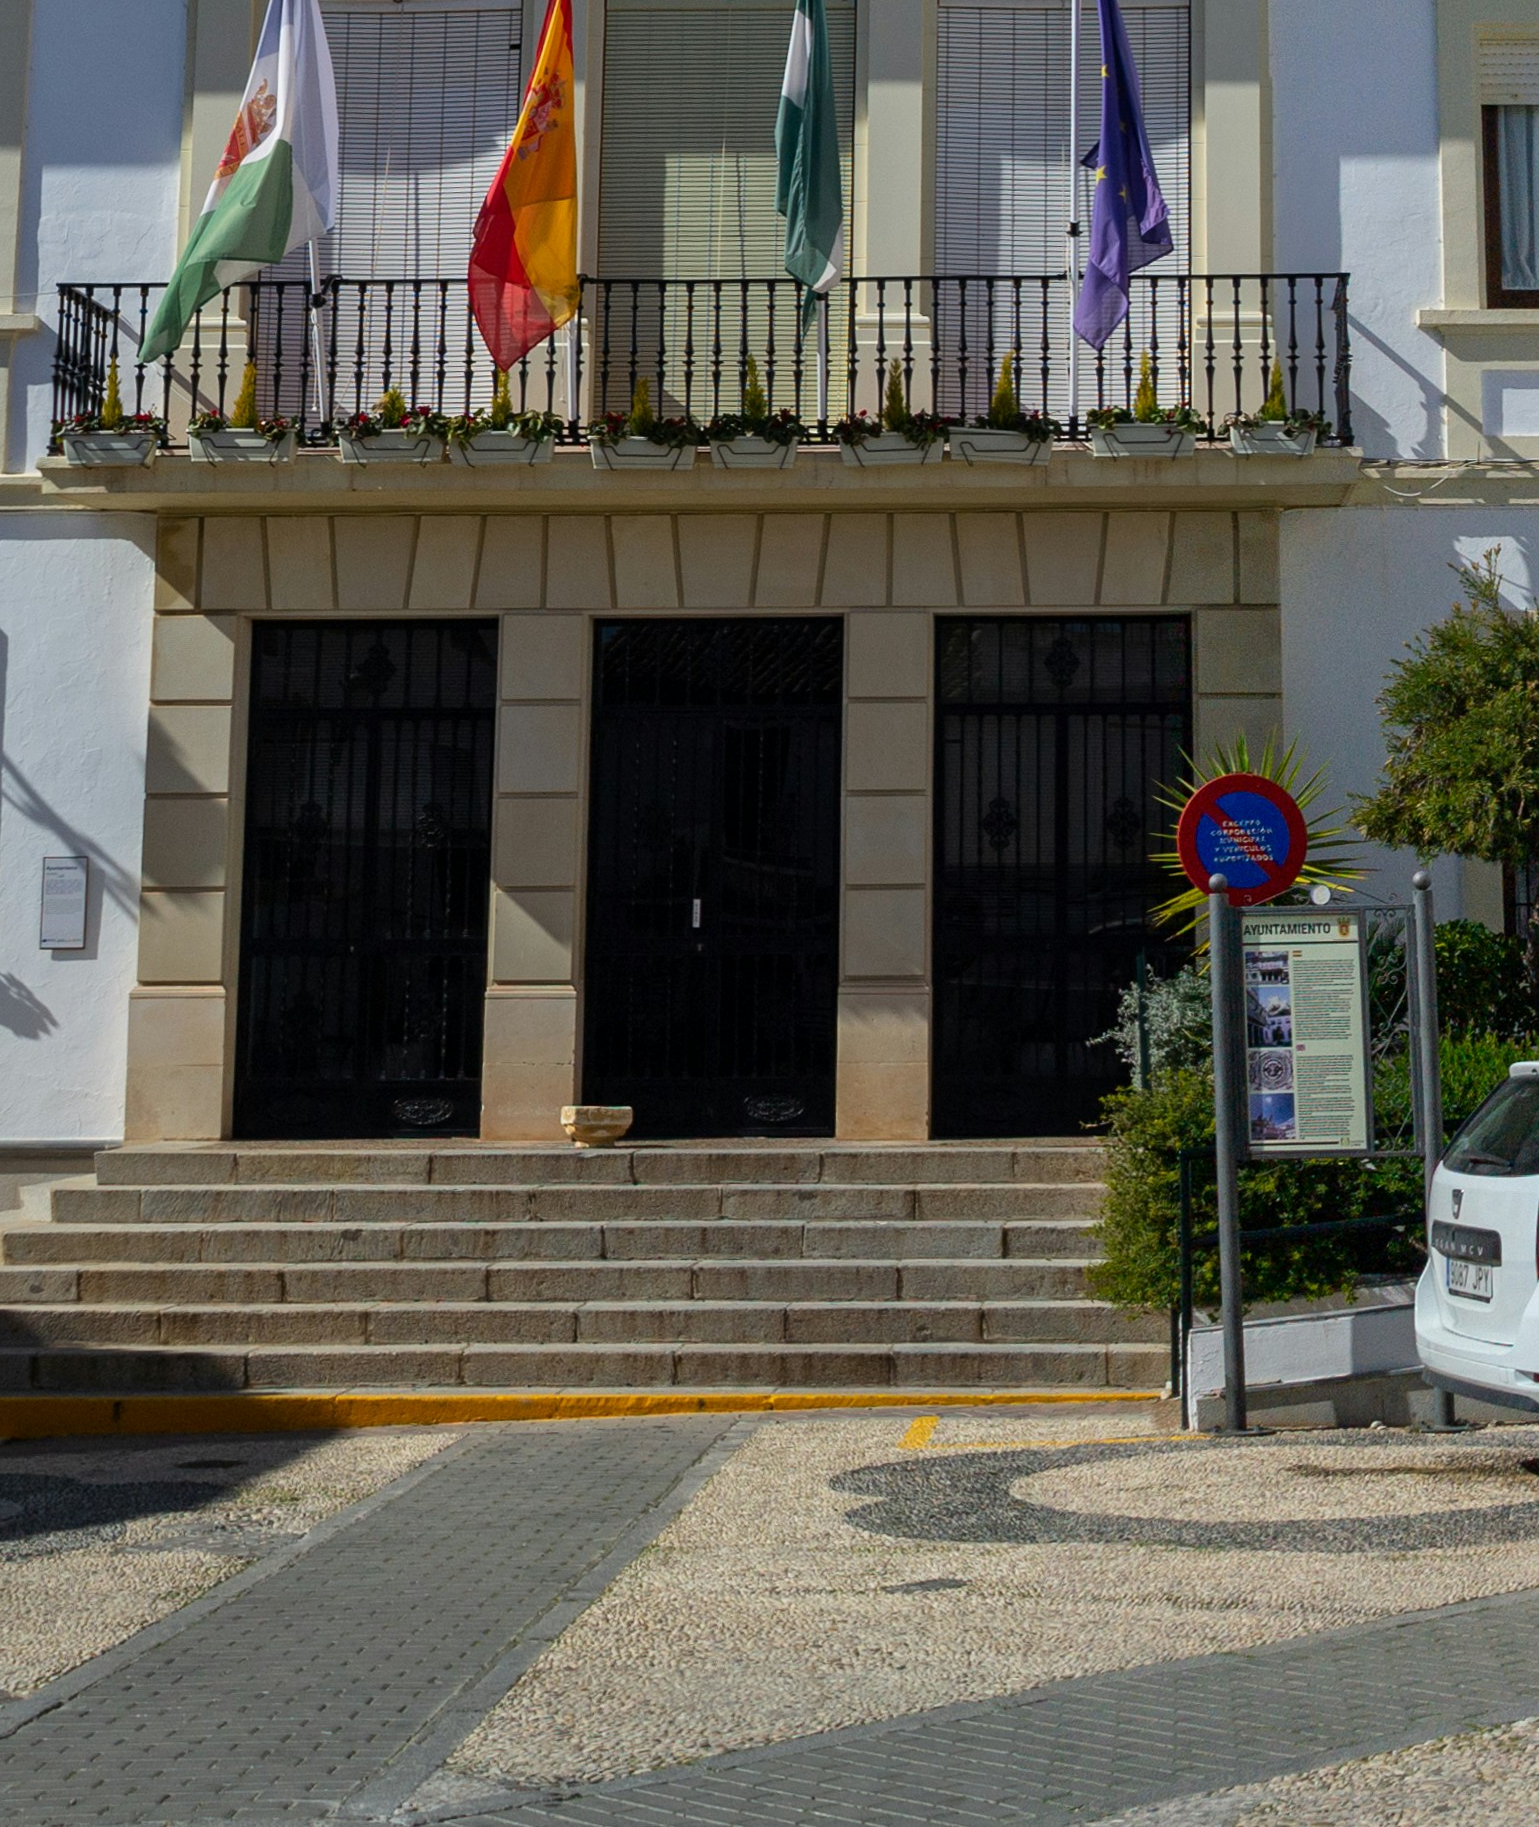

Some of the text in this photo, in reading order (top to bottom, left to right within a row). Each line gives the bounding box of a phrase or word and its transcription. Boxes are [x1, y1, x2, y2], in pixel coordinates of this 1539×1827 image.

[1219, 836, 1266, 844] MUNICIPAL
[1214, 854, 1274, 862] AUTORIZADOS
[1243, 922, 1331, 936] AYUNTAMIENTO
[1461, 1244, 1484, 1256] MCV
[1473, 1266, 1490, 1292] JPY
